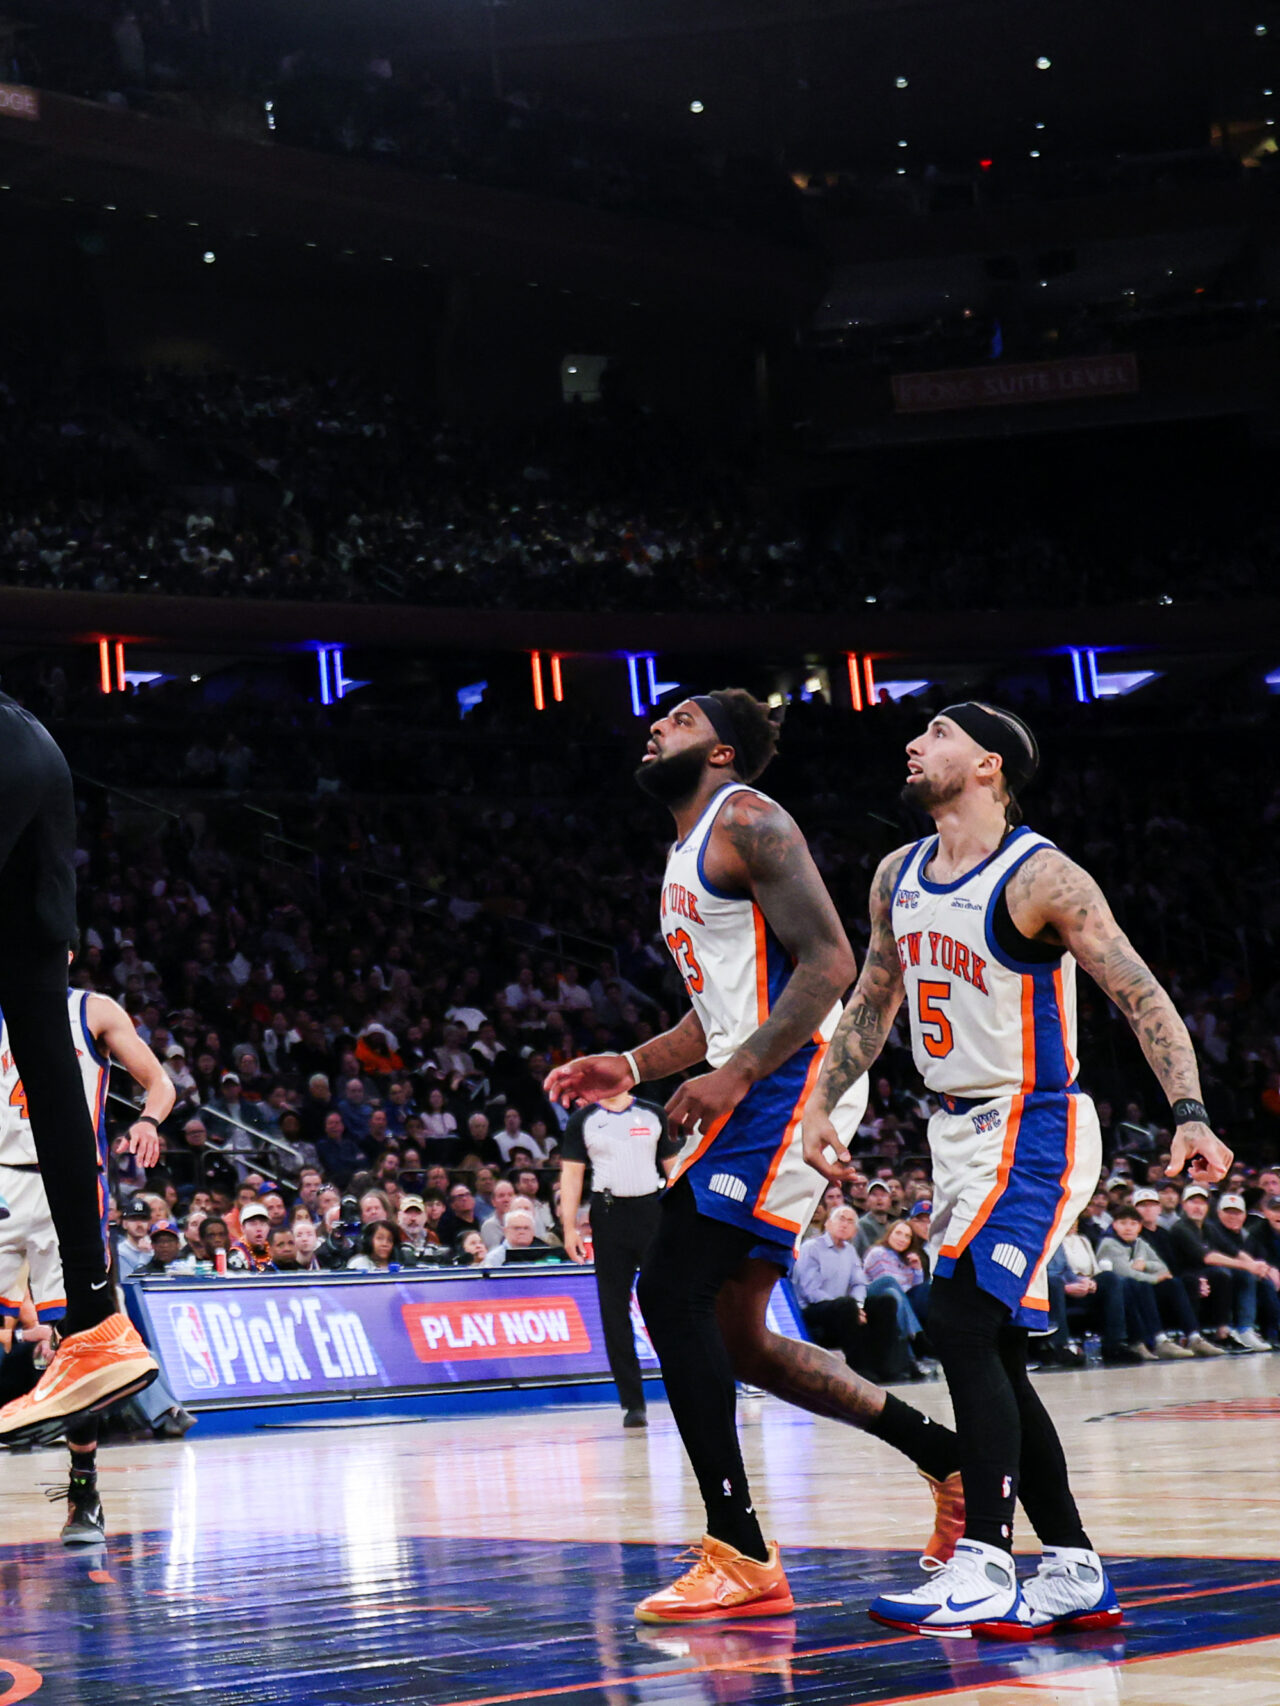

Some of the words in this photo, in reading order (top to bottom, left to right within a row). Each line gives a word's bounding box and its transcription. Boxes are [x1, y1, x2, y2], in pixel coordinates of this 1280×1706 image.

[983, 372, 1049, 396] SUITE
[1058, 365, 1128, 390] LEVEL
[896, 931, 923, 976] EW
[928, 930, 989, 997] YORK
[918, 978, 954, 1060] 5
[972, 1108, 1001, 1135] NYC
[420, 1312, 497, 1350] PLAY
[500, 1308, 570, 1345] NOW
